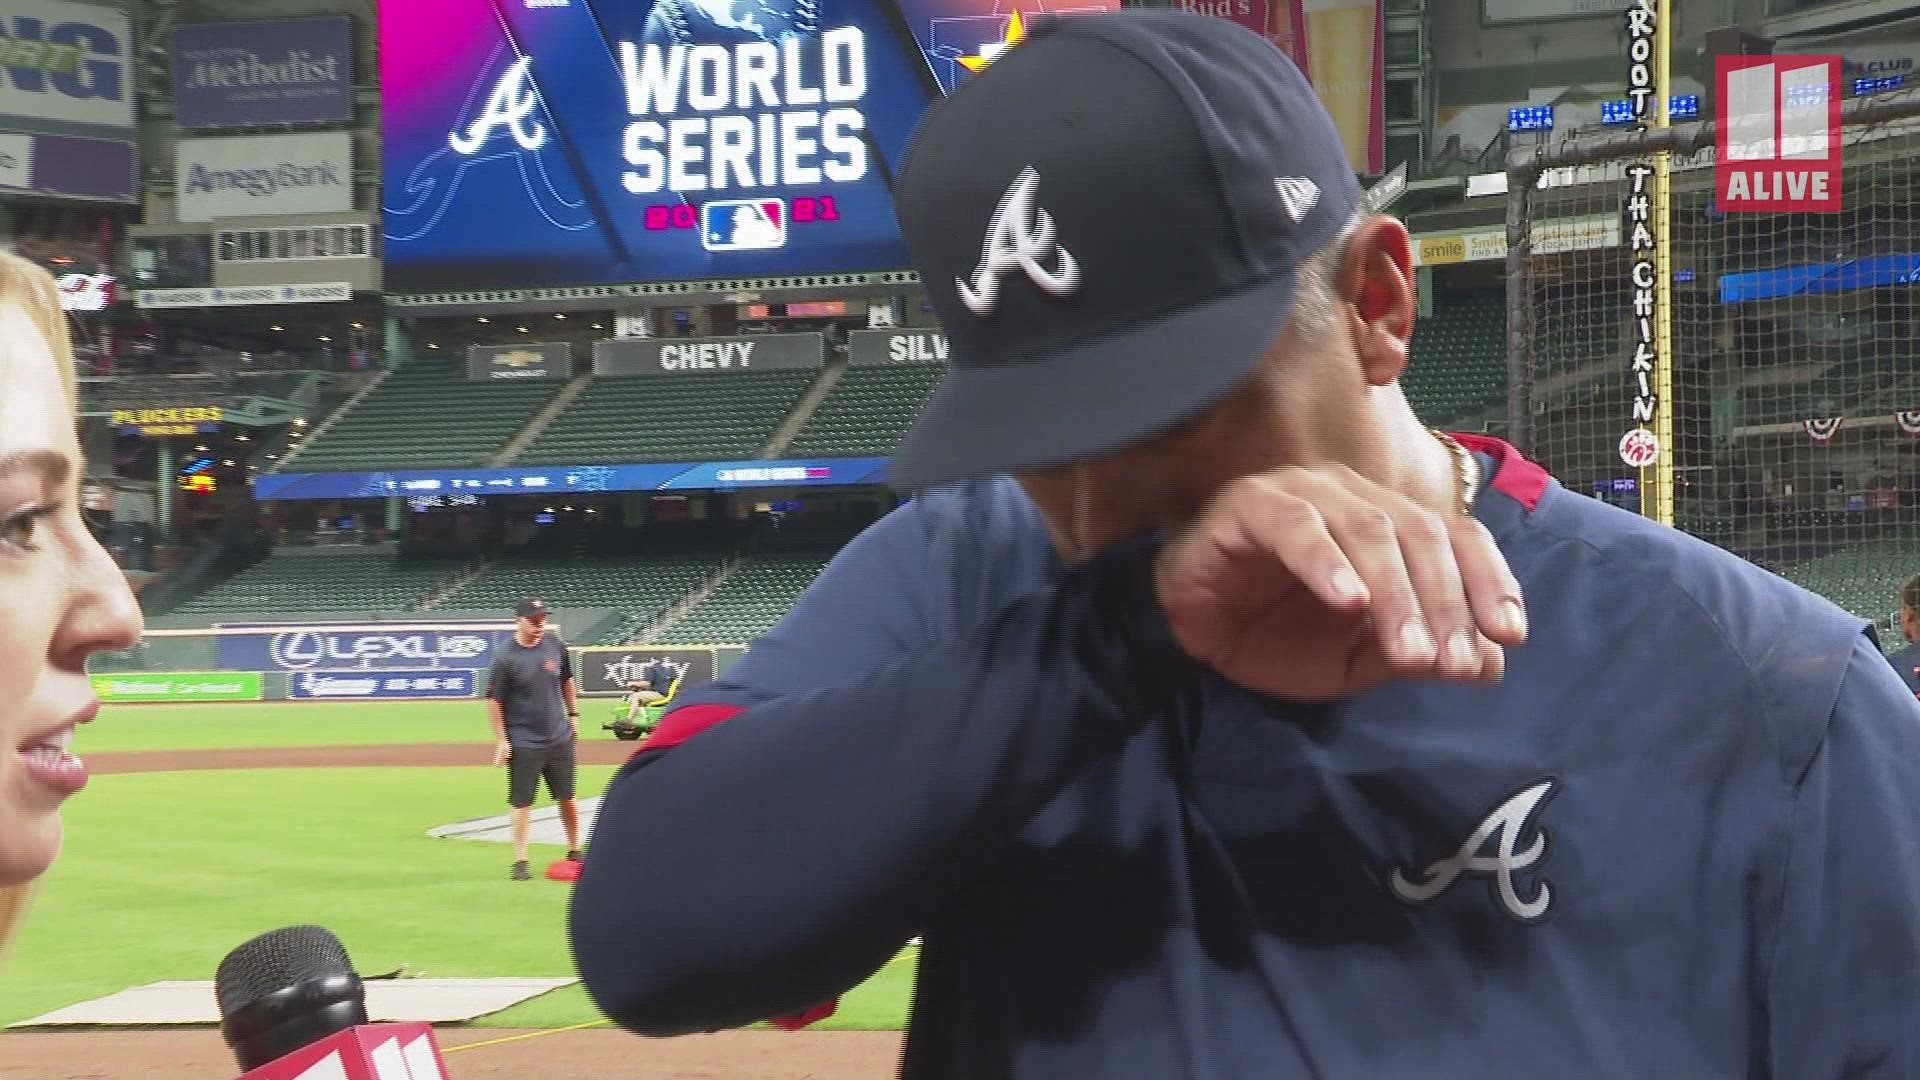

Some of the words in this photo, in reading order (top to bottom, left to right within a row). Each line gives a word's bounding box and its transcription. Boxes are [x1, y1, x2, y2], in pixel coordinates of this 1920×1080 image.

[184, 51, 340, 89] Methodist
[620, 25, 867, 116] WORLD
[1868, 57, 1912, 72] CLUB
[621, 107, 867, 194] SERIES
[643, 203, 697, 231] 20
[792, 197, 840, 222] 21
[1423, 243, 1463, 259] smile
[226, 289, 276, 301] NABORS
[297, 286, 347, 298] NABORS
[1632, 262, 1656, 421] CHIKIN
[659, 342, 755, 370] CHEVY
[112, 406, 223, 425] PLUCKERS
